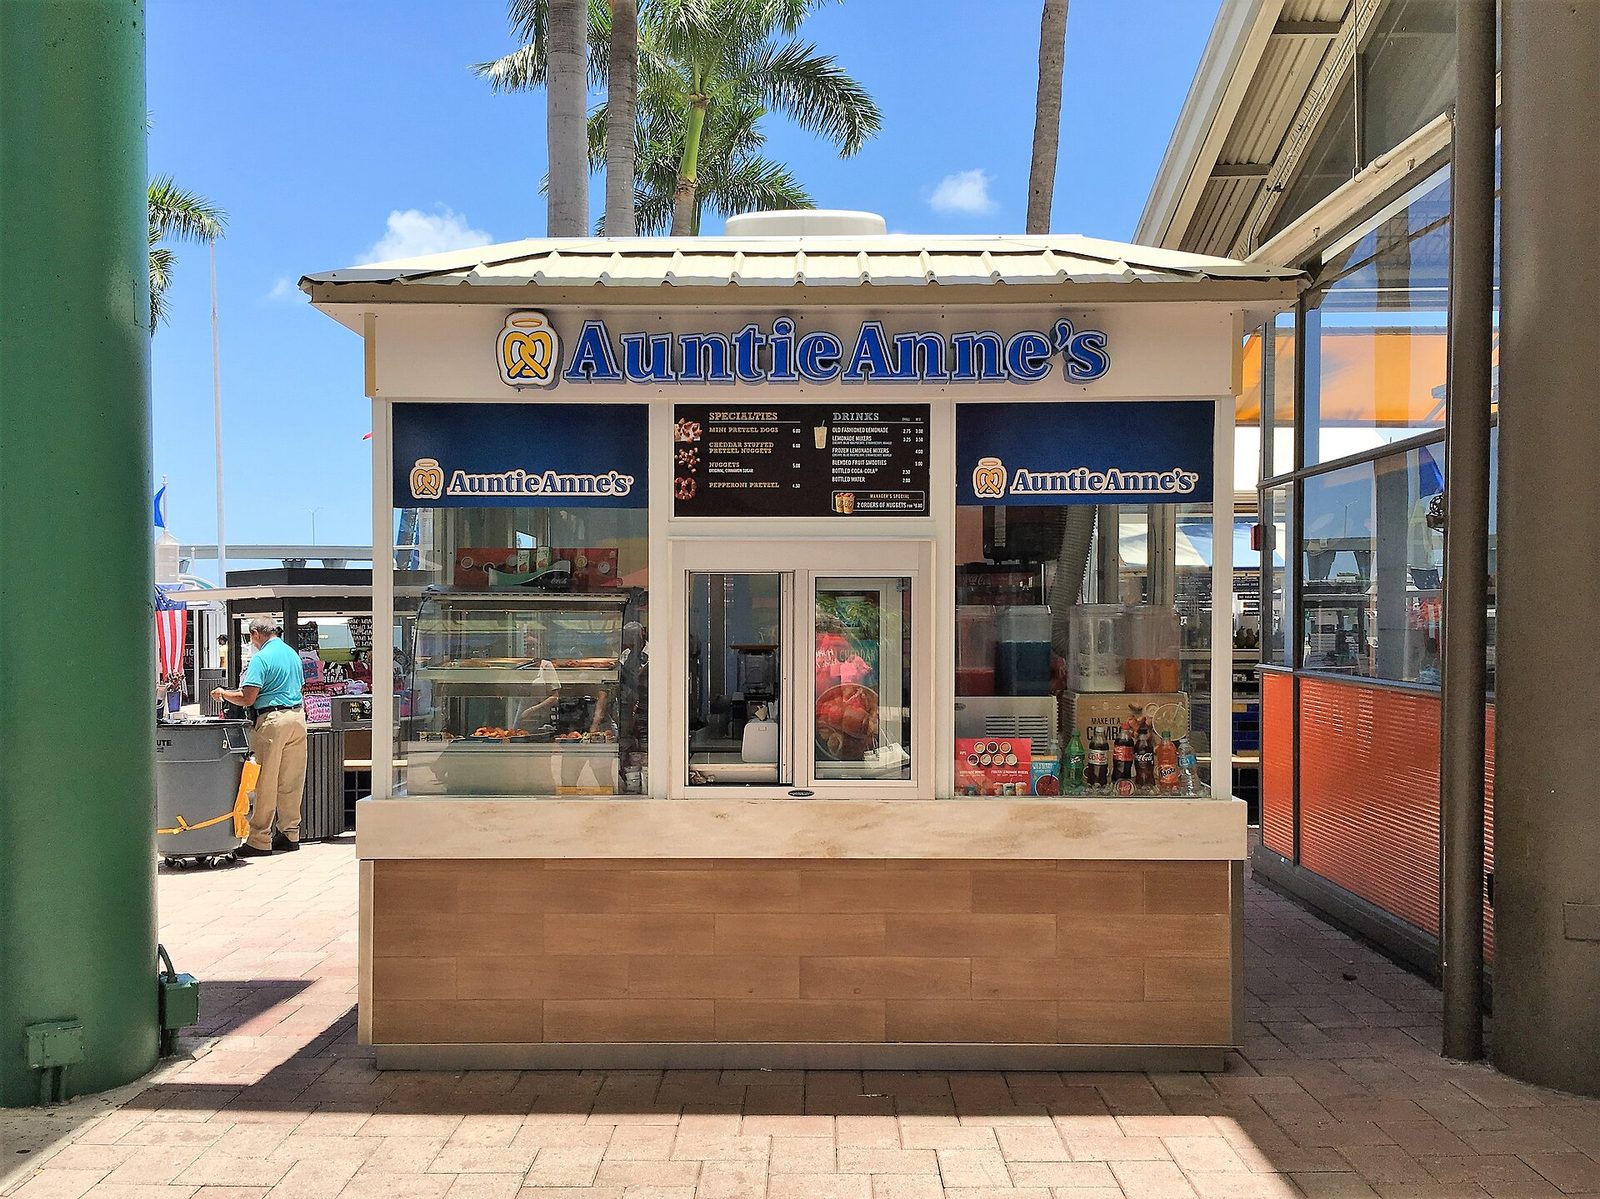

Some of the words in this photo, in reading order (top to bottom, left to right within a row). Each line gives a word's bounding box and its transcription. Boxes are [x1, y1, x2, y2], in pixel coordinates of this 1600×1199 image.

[708, 412, 778, 421] SPECIALTIES
[832, 412, 880, 421] DRINKS
[1091, 717, 1109, 725] MAKE
[1109, 717, 1116, 725] IT
[1116, 717, 1121, 725] A
[1086, 726, 1121, 741] CMB
